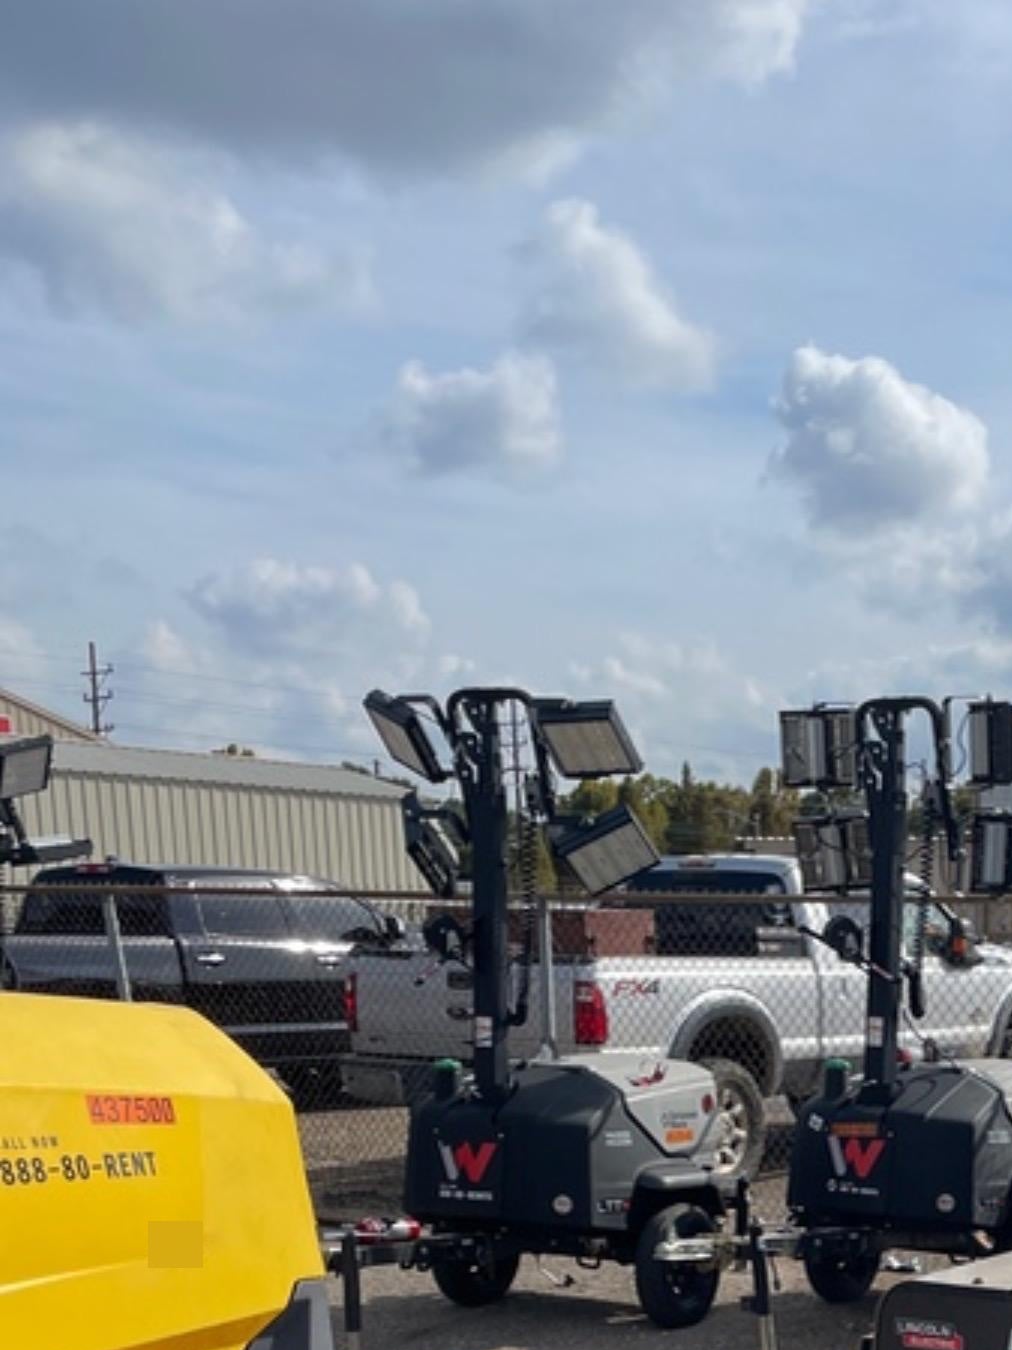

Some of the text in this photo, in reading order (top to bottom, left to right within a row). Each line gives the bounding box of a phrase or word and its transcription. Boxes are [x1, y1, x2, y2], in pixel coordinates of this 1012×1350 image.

[91, 1096, 174, 1124] 437500
[0, 1137, 27, 1150] ALL
[0, 1152, 157, 1186] 888-80-RENT
